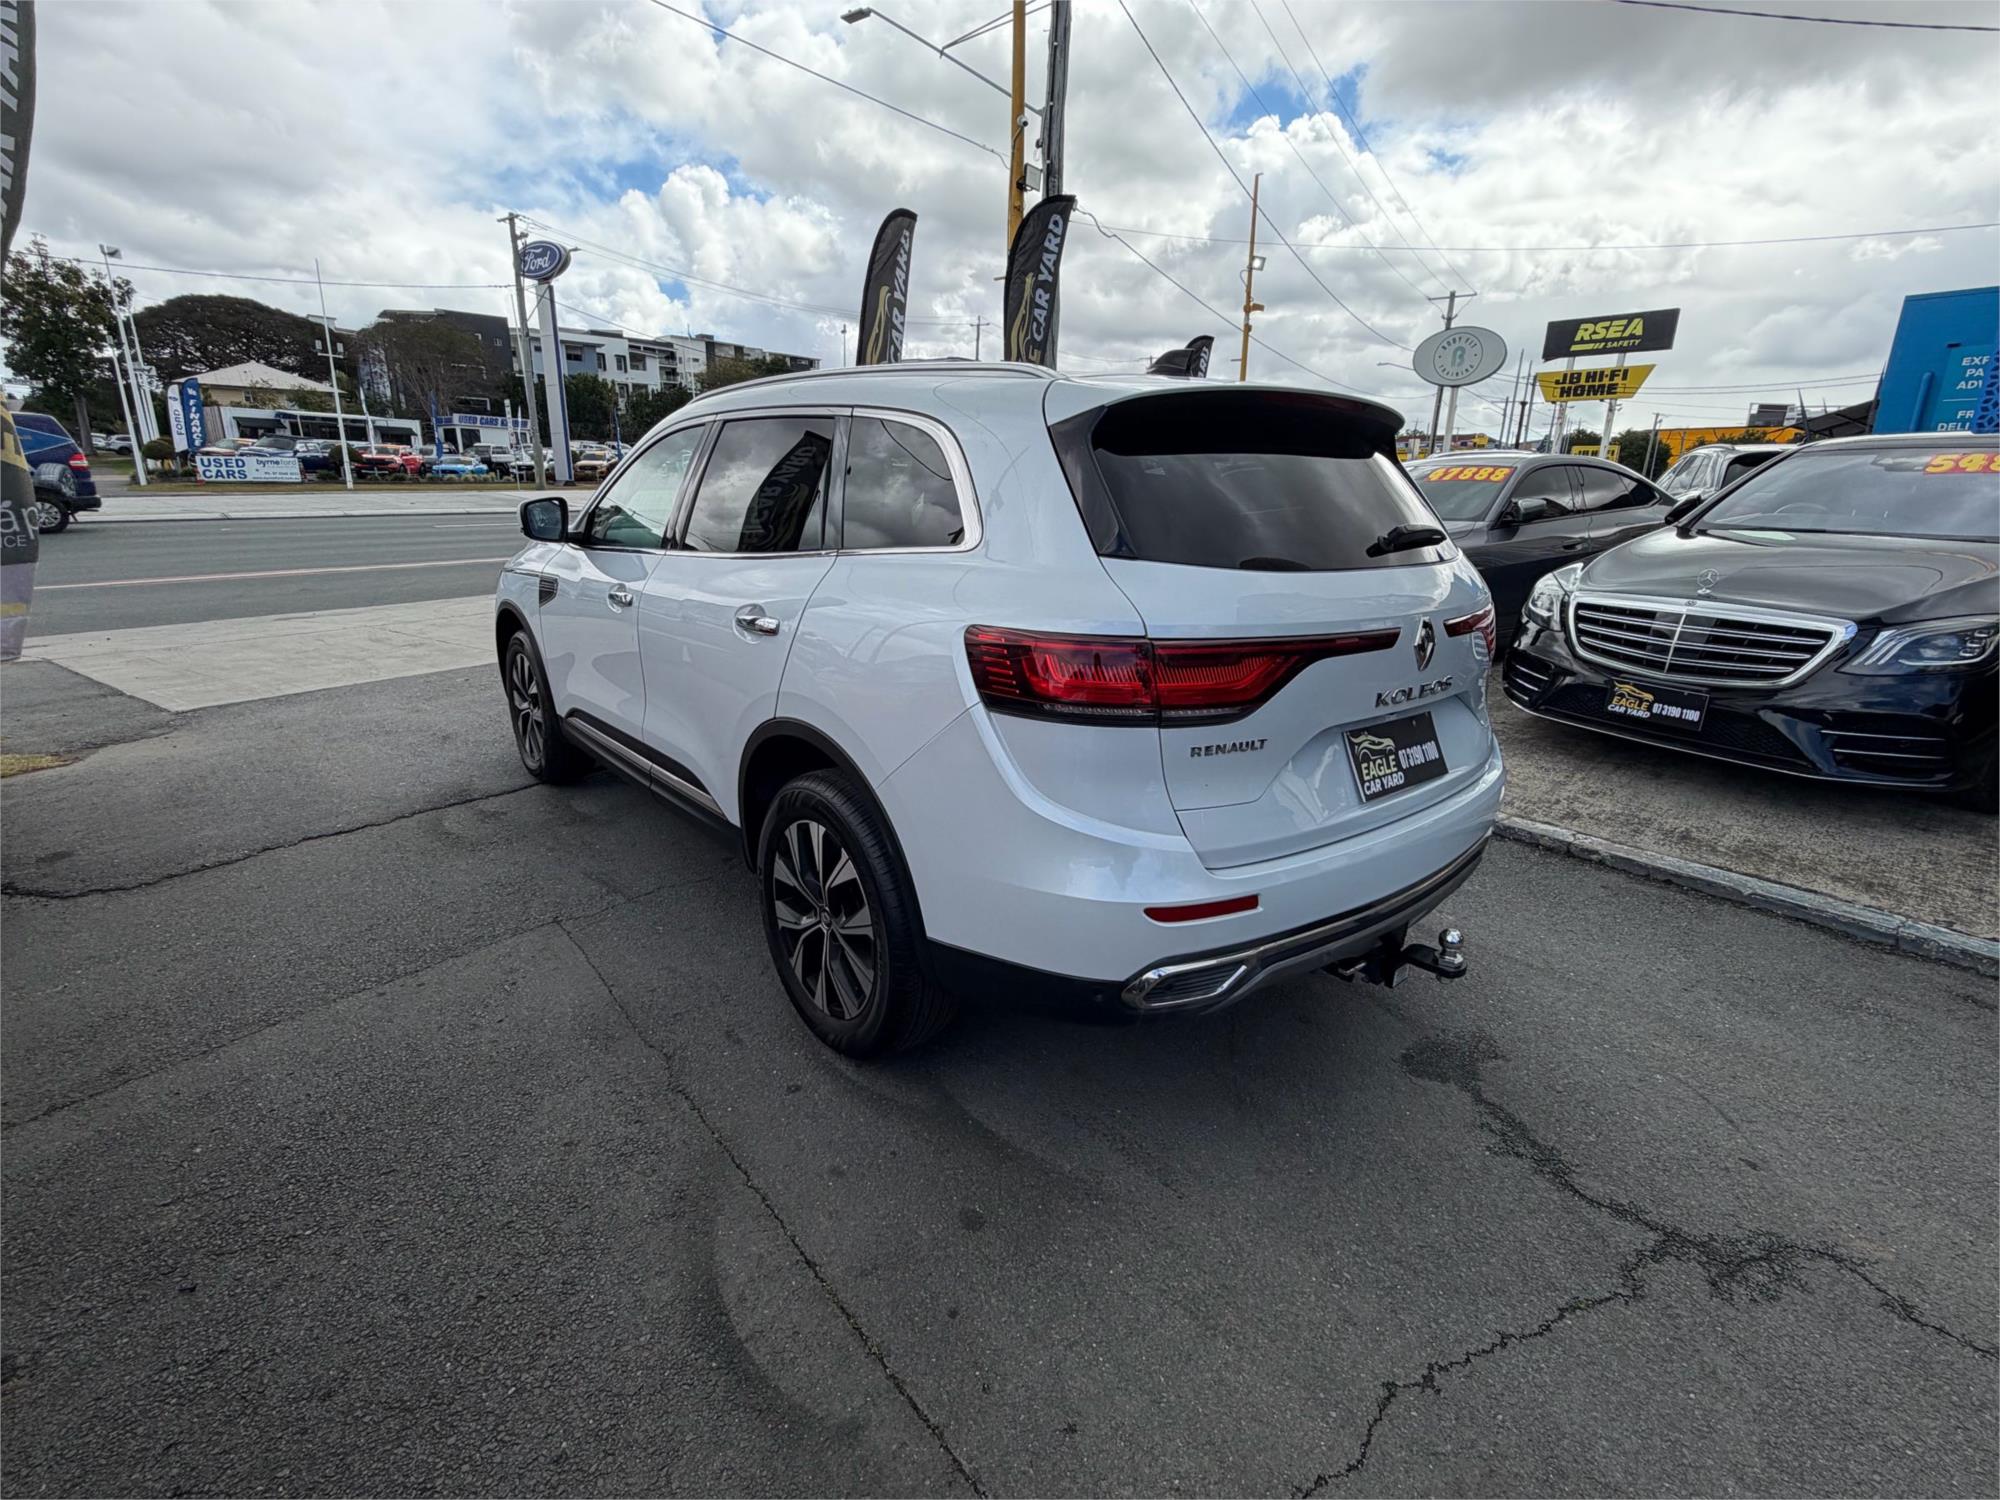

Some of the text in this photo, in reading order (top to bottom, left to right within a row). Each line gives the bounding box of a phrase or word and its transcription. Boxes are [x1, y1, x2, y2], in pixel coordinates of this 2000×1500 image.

[1038, 213, 1064, 283] YARD
[524, 247, 551, 272] Ford
[1032, 287, 1050, 343] CAR
[1574, 318, 1644, 342] RSEA
[1606, 339, 1641, 349] SAFETY
[1554, 372, 1582, 385] JB
[1559, 383, 1619, 398] HOME
[173, 409, 185, 436] FORD
[188, 399, 203, 447] FINANCE
[458, 415, 478, 425] USED
[479, 417, 499, 426] CARS
[200, 457, 246, 469] USED
[202, 469, 247, 480] CARS
[1374, 675, 1453, 708] KOLEOS
[1608, 704, 1651, 718] CAR YARD
[1612, 695, 1650, 711] EAGLE
[1652, 702, 1700, 722] 07 3190 1100
[1190, 738, 1268, 757] RENAULT
[1398, 739, 1440, 770] 07 3190 1100
[1361, 754, 1398, 782] EAGLE
[1364, 771, 1405, 796] CAR YARD
